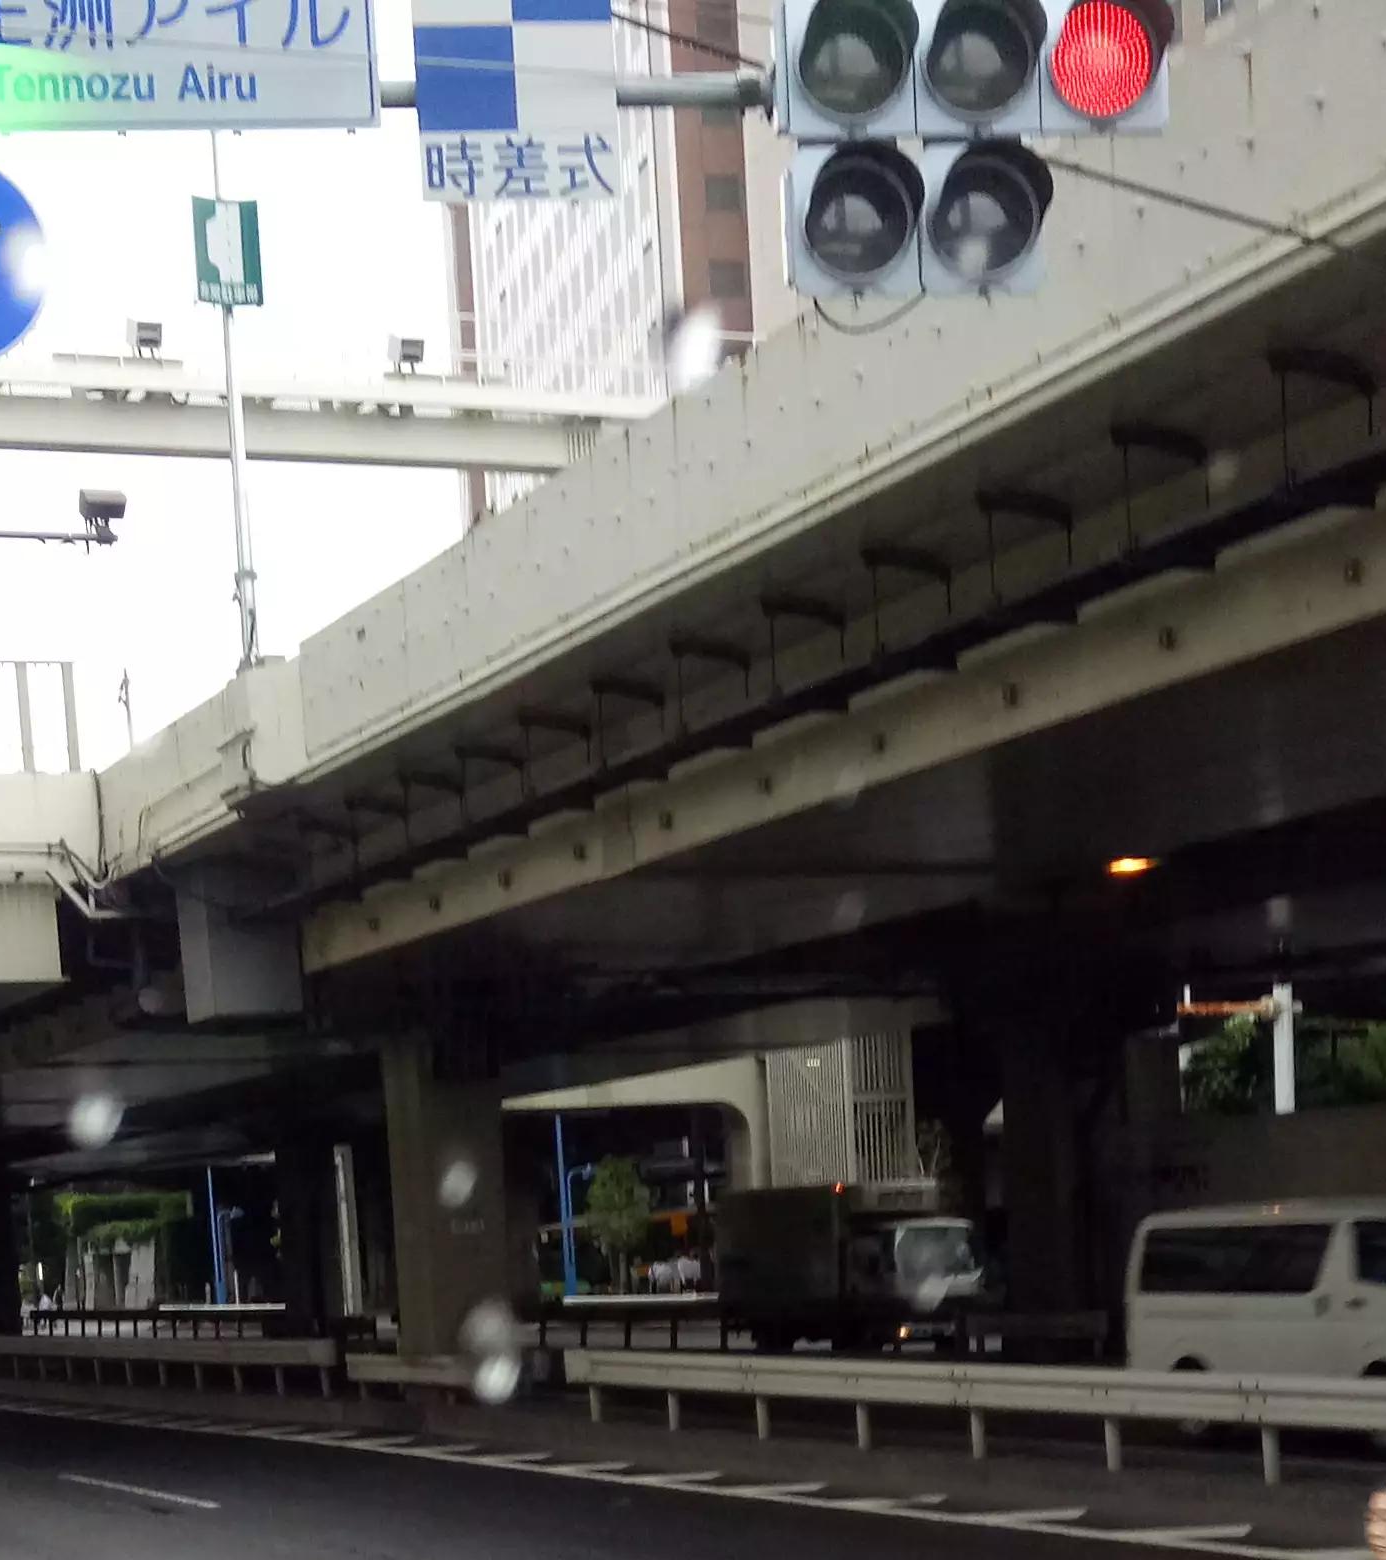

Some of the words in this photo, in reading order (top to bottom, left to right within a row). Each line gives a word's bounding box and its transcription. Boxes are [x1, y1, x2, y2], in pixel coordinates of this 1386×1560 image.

[178, 61, 258, 103] Airu
[425, 133, 614, 199] 時差式
